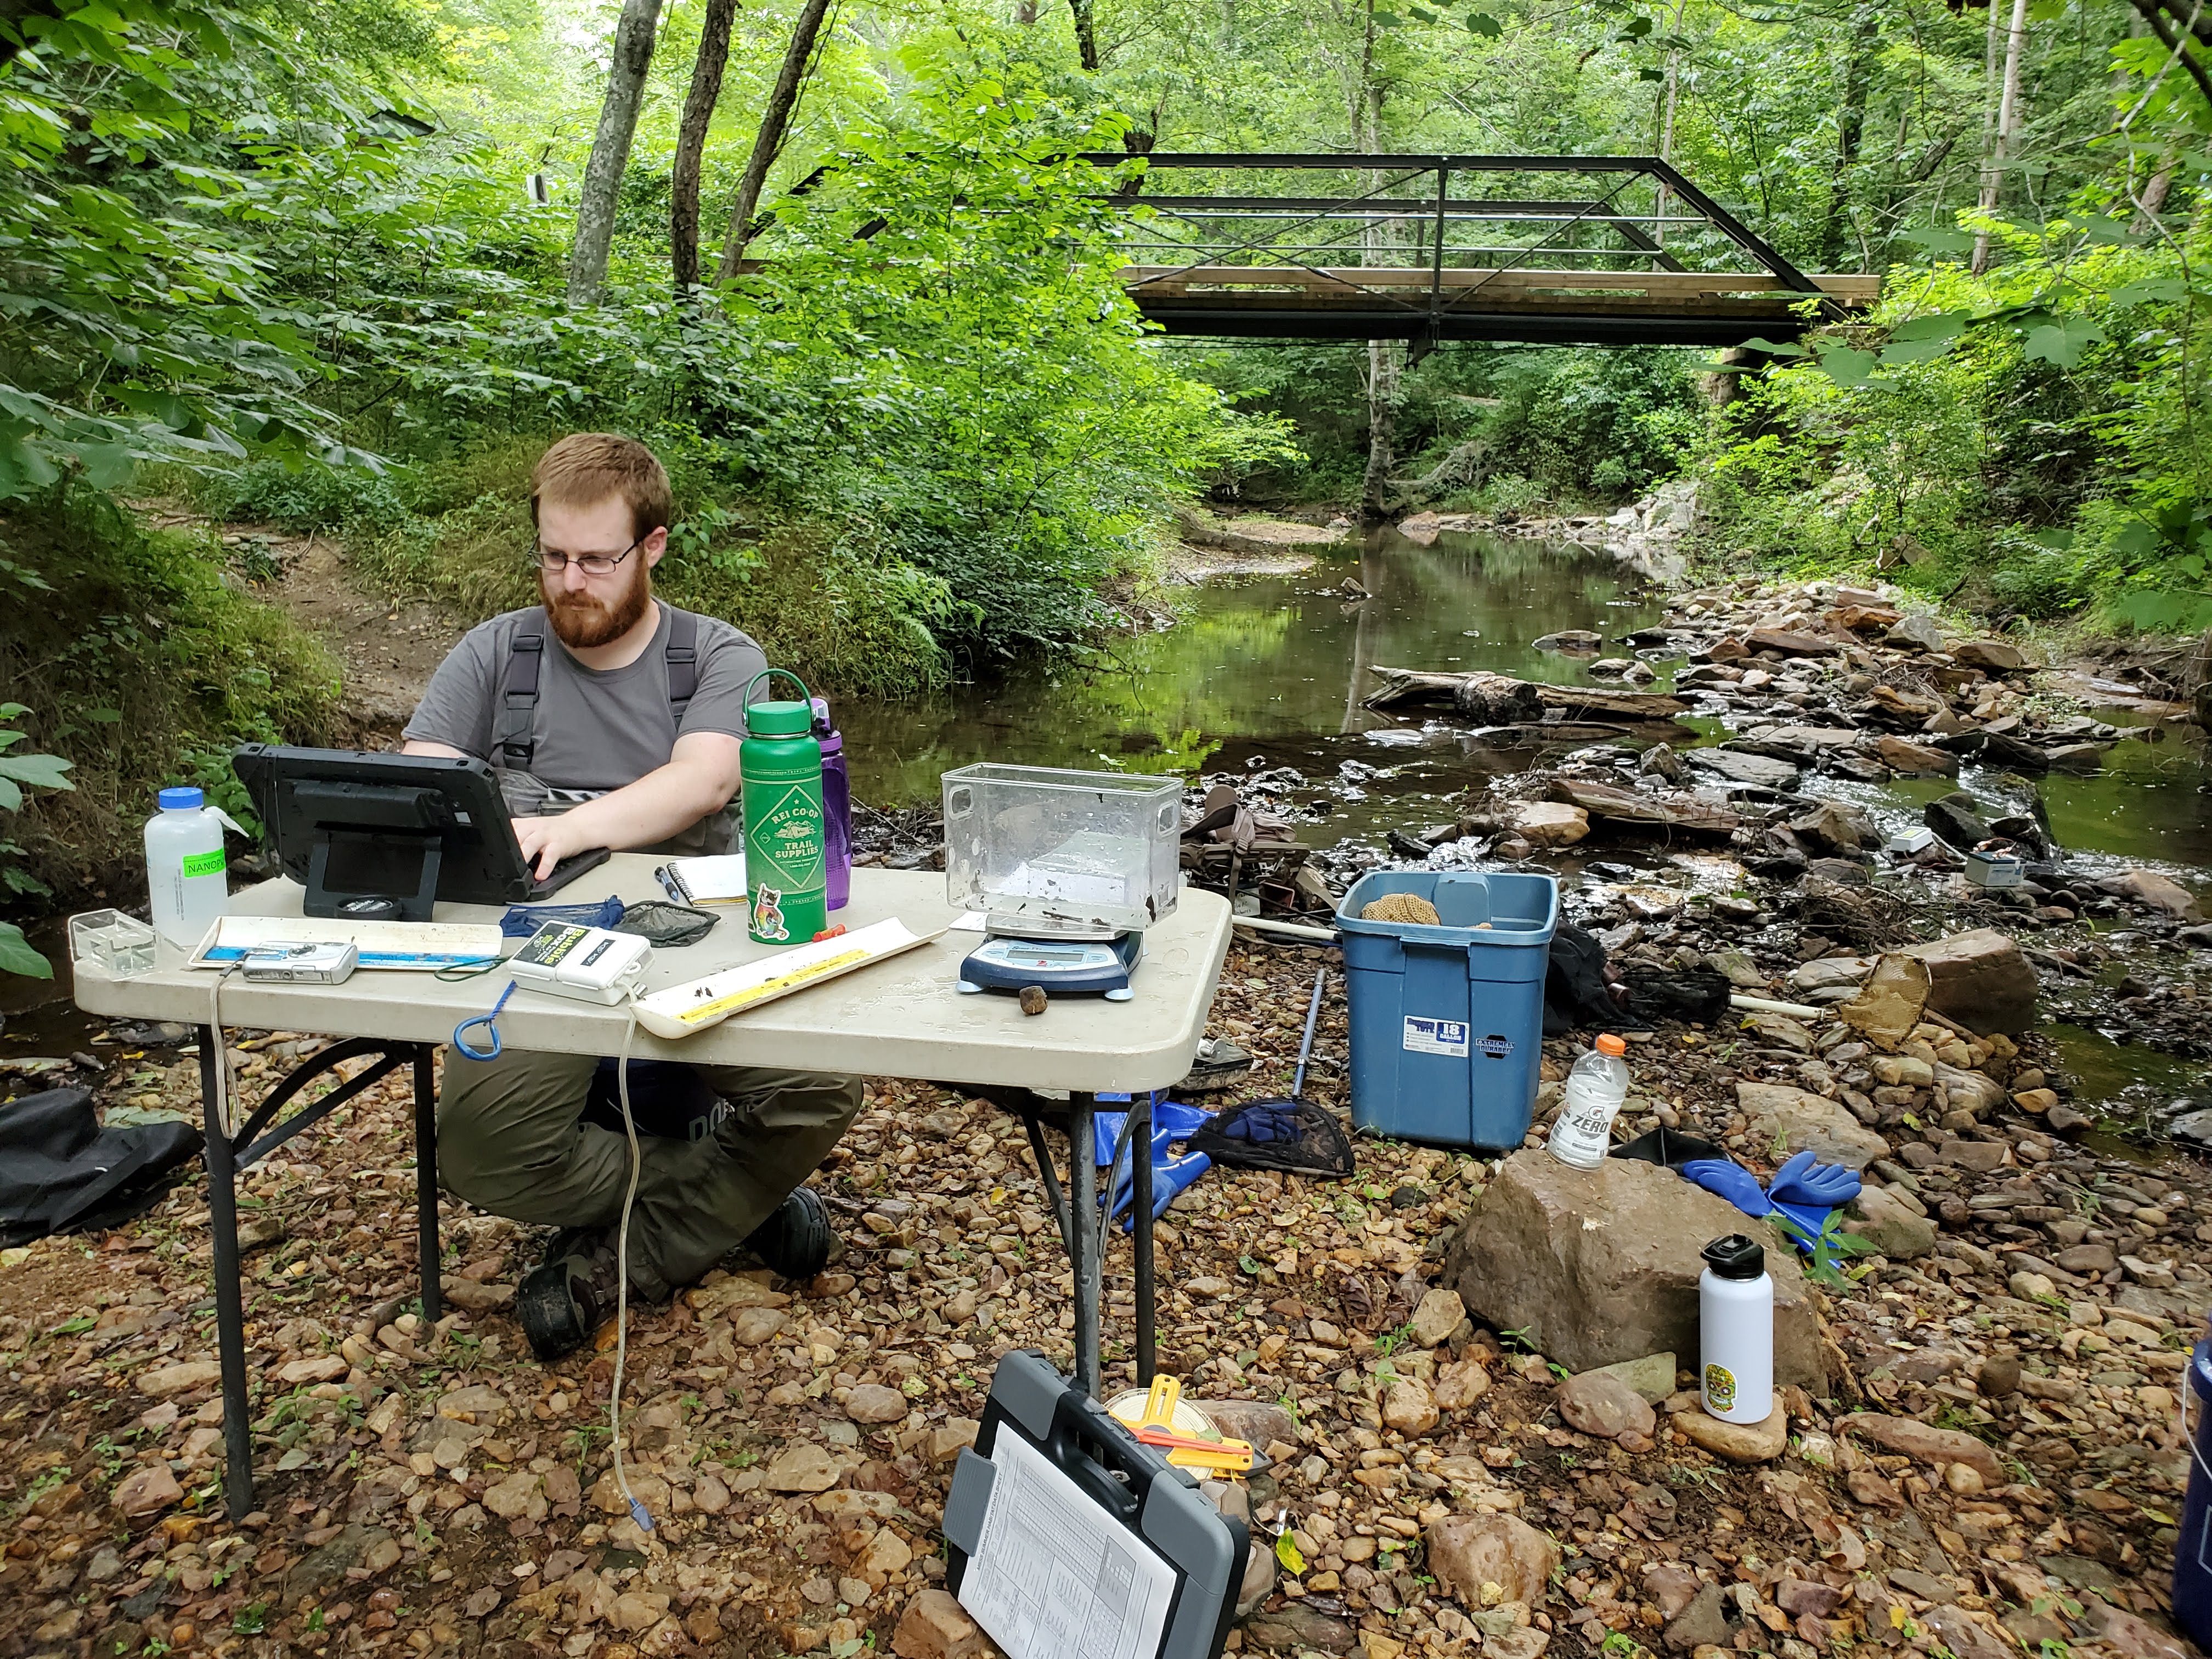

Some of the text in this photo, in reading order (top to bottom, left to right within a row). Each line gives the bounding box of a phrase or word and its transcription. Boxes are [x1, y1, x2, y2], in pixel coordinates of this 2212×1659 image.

[771, 810, 791, 824] REI
[775, 846, 818, 858] SUPPLIES
[785, 840, 813, 850] TRAIL
[550, 927, 577, 949] Box
[544, 928, 586, 964] Bubble
[1443, 1023, 1459, 1035] 18
[1476, 1039, 1515, 1047] EXTREMELY
[1588, 1105, 1605, 1120] G
[1571, 1115, 1609, 1133] ZERO
